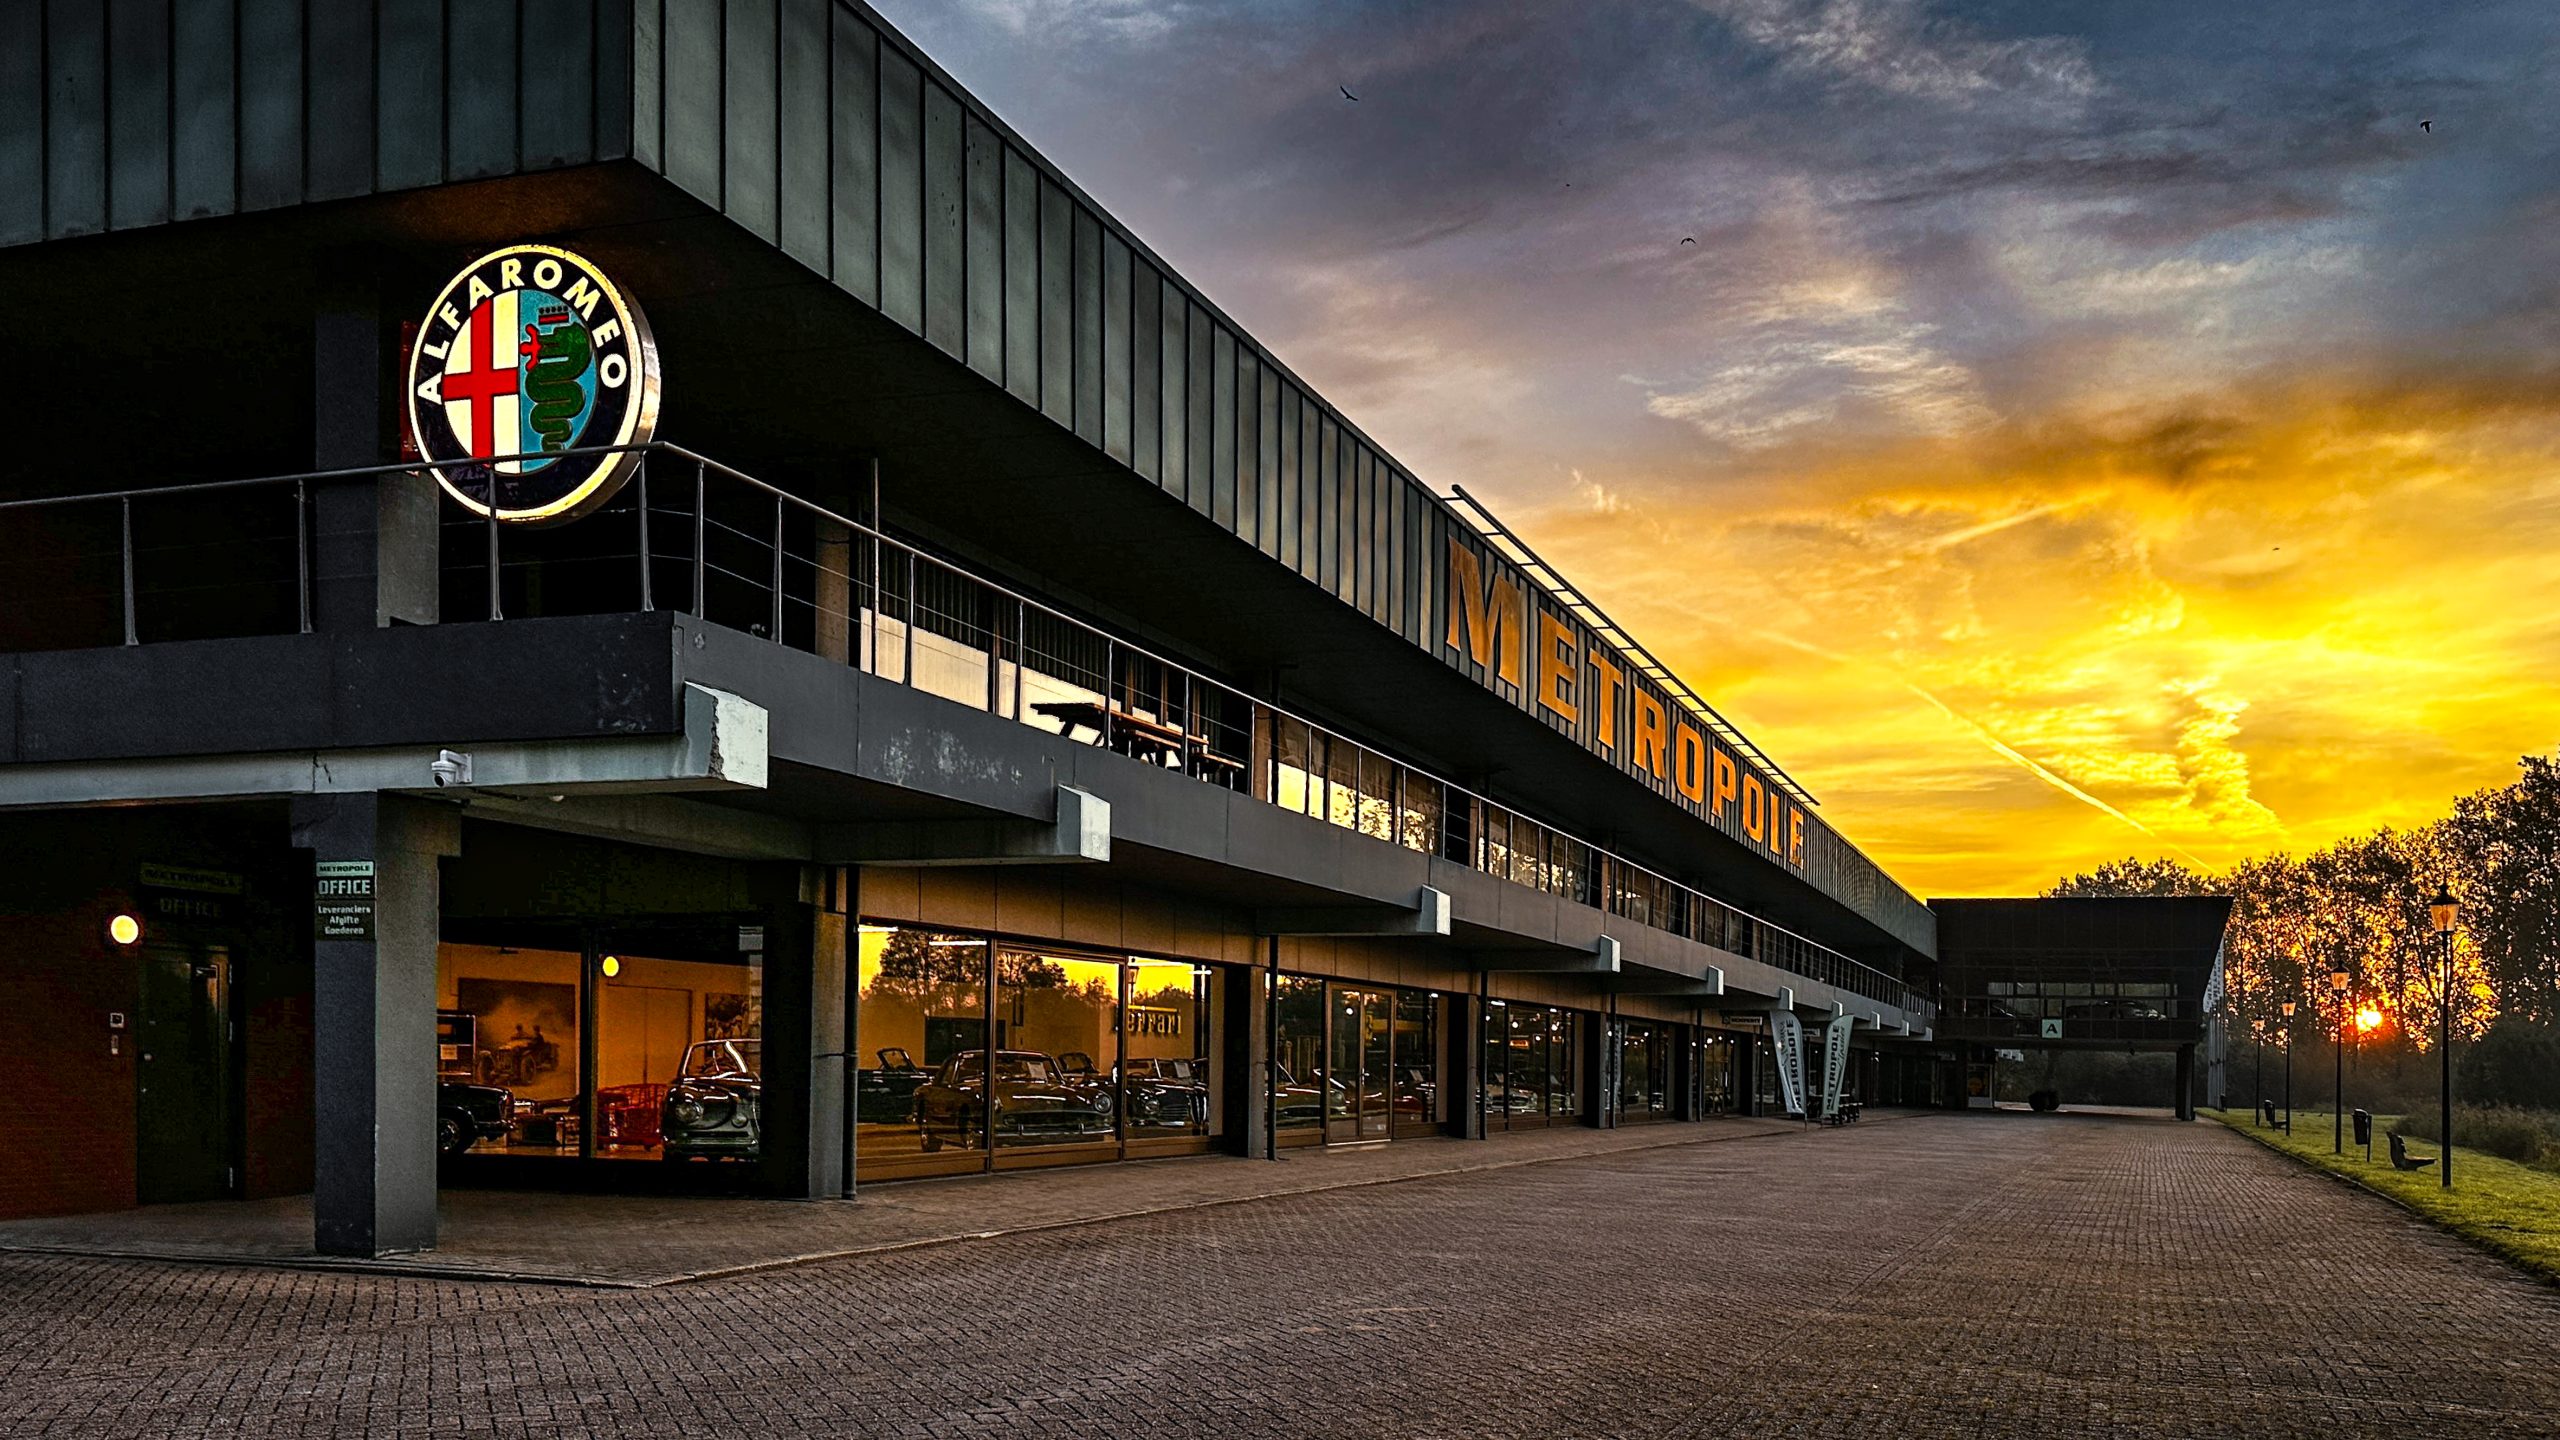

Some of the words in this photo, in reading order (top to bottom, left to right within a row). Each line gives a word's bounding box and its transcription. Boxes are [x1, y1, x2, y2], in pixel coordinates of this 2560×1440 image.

[1447, 534, 1804, 870] METROPOLE
[319, 879, 371, 895] OFFICE
[2045, 1023, 2058, 1034] A
[1826, 1024, 1840, 1110] METROPOLE
